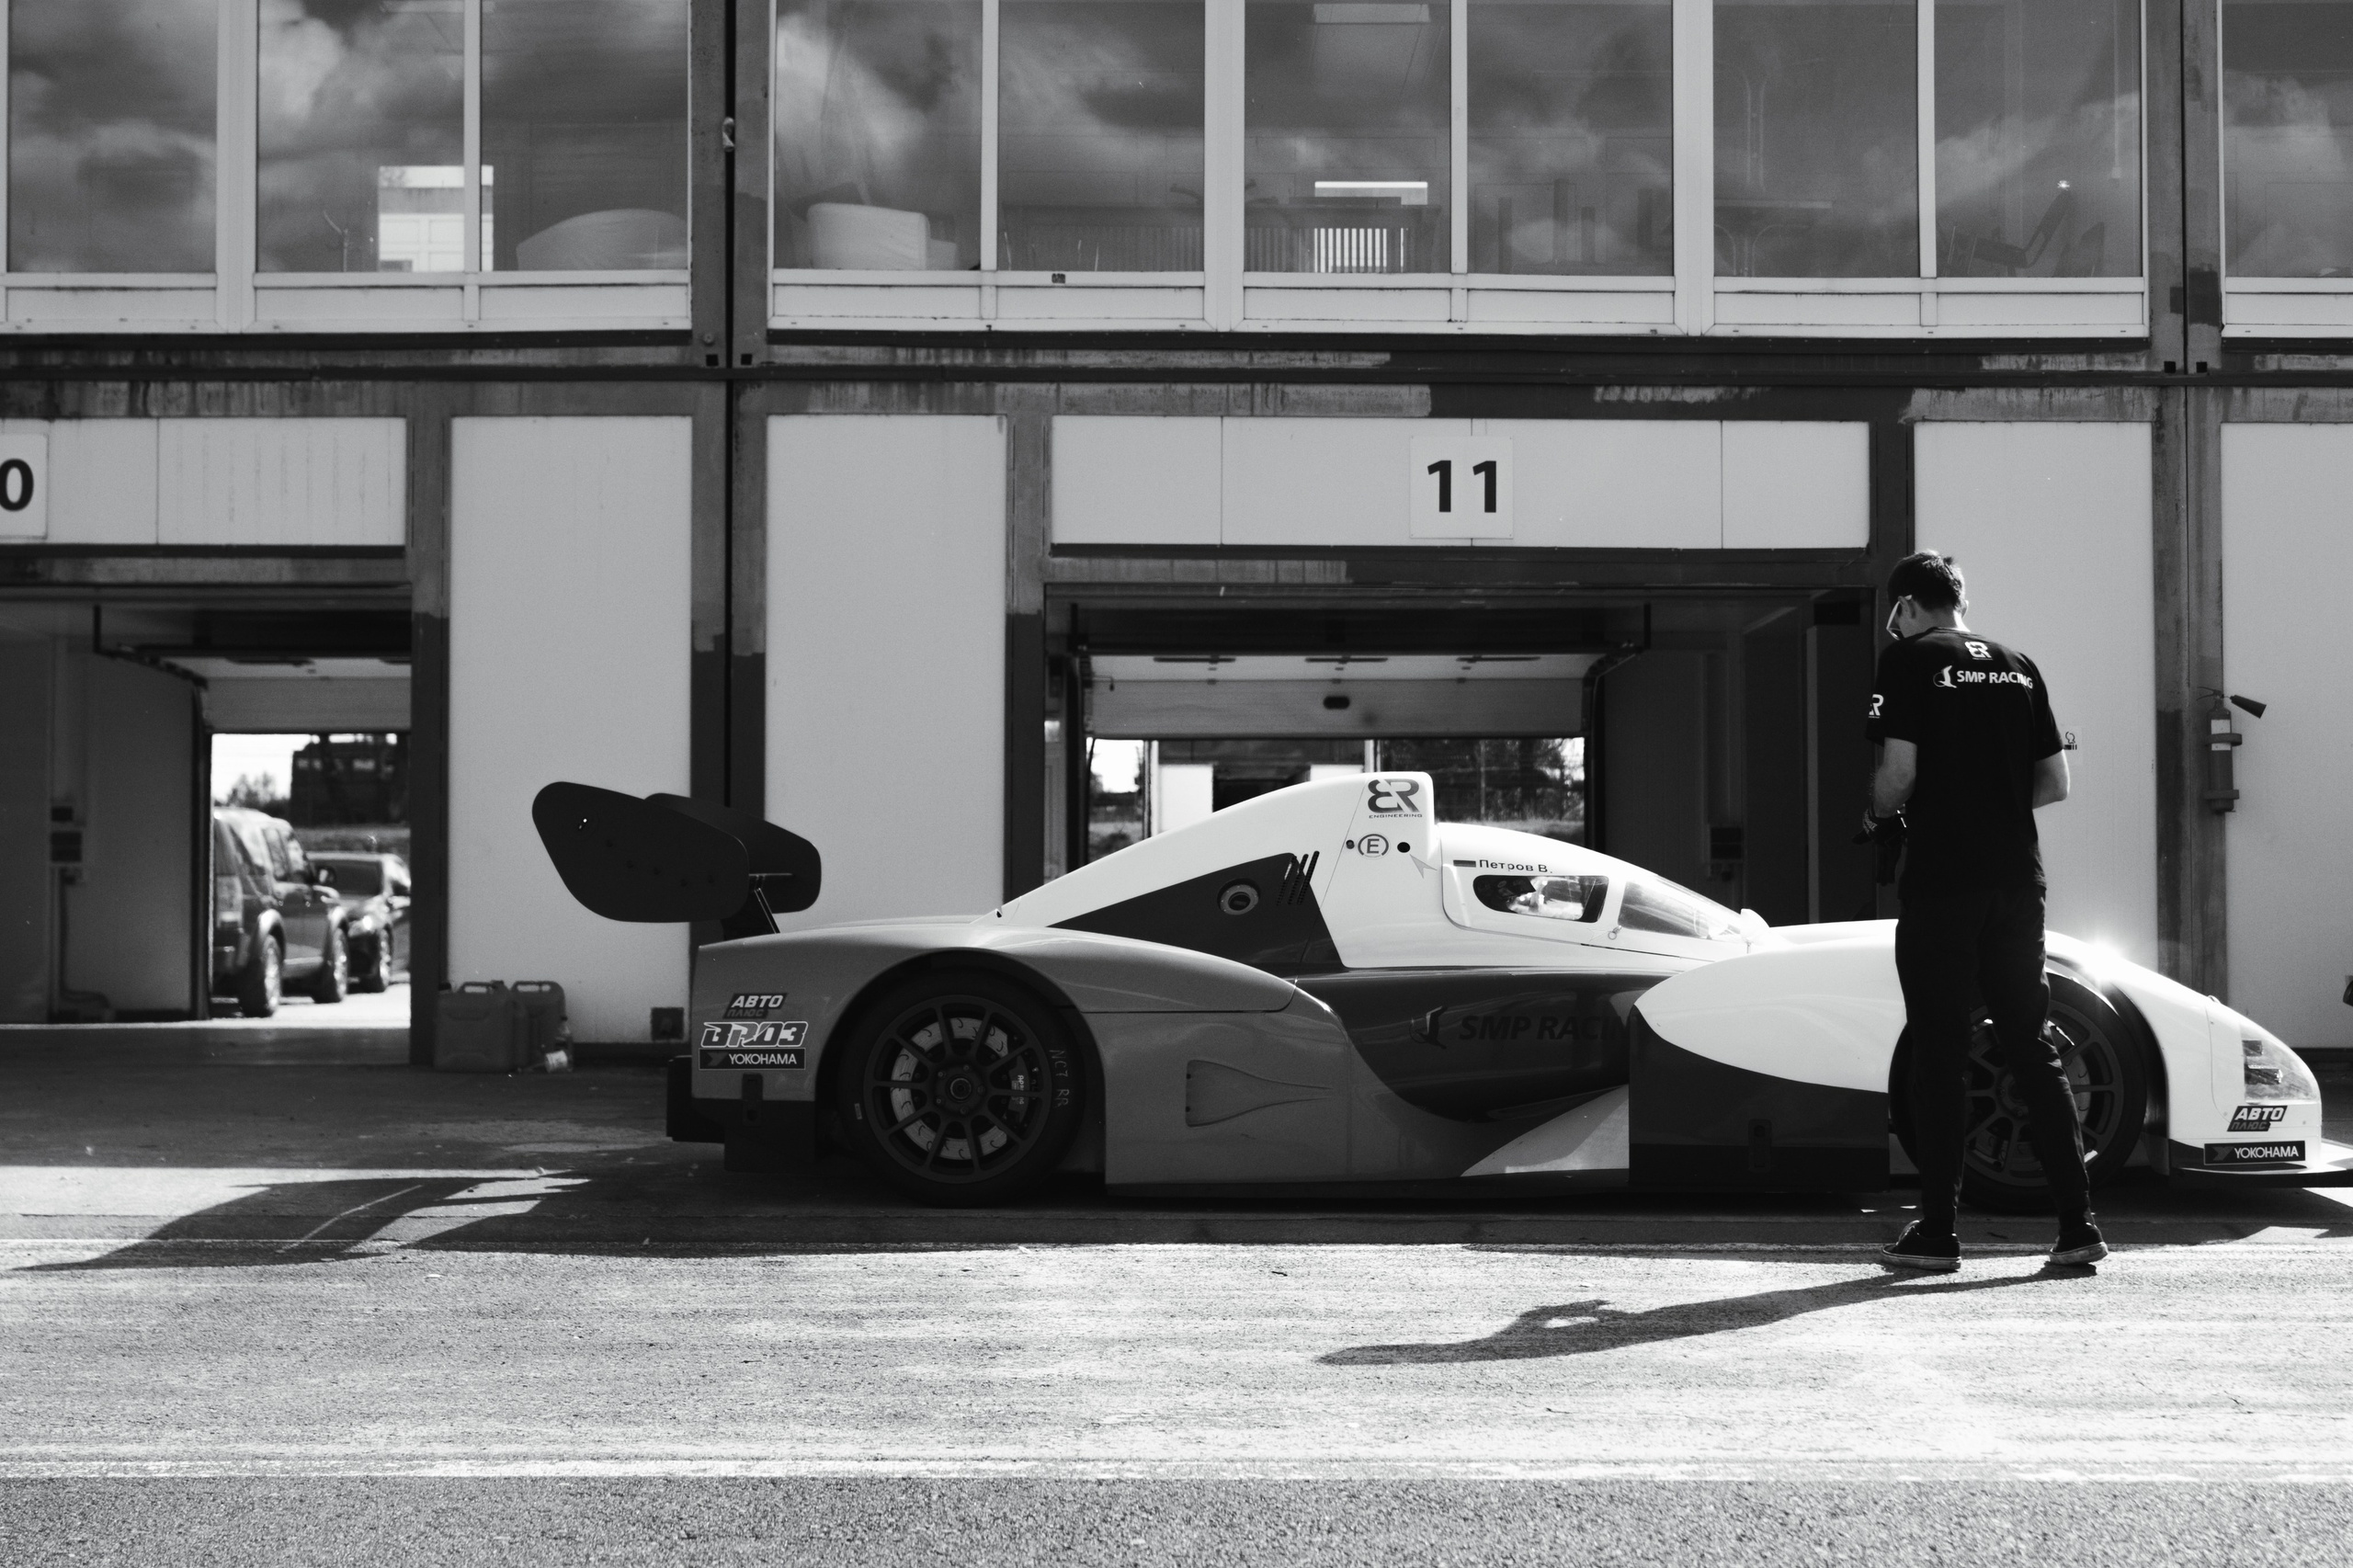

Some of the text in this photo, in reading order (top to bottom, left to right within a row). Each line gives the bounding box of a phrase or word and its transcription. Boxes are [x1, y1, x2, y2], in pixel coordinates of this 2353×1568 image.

[1427, 460, 1497, 513] 11
[1957, 670, 2033, 688] SMP RACING
[1367, 838, 1379, 854] E
[1479, 858, 1534, 872] Петров
[731, 994, 784, 1008] АВТО
[726, 1008, 765, 1017] ПЛЮС
[1459, 1015, 1531, 1040] SMP
[728, 1053, 797, 1065] YOKOHAMA
[2234, 1107, 2285, 1120] АВТО
[2230, 1121, 2268, 1130] ПЛЮС
[2234, 1145, 2299, 1159] YOKOHAMA
